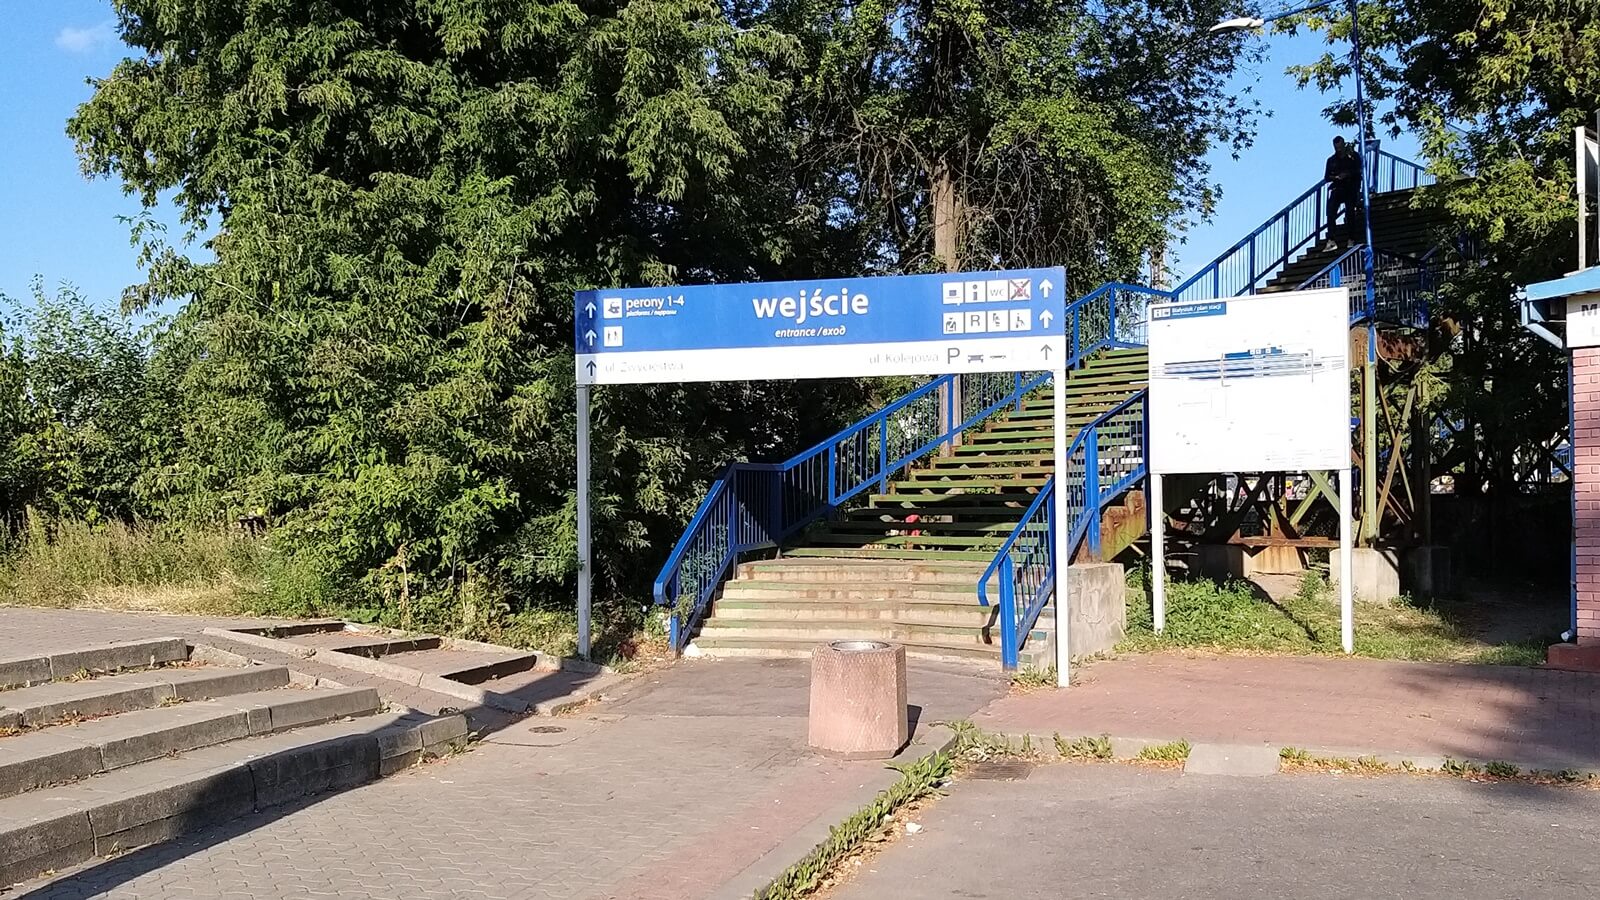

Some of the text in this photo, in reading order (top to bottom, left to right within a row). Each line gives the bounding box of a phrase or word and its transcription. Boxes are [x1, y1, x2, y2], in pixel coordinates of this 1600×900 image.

[626, 295, 685, 310] perony 1-4
[752, 287, 869, 324] wejście
[970, 314, 981, 327] R
[775, 328, 816, 338] entrance
[947, 347, 961, 365] P
